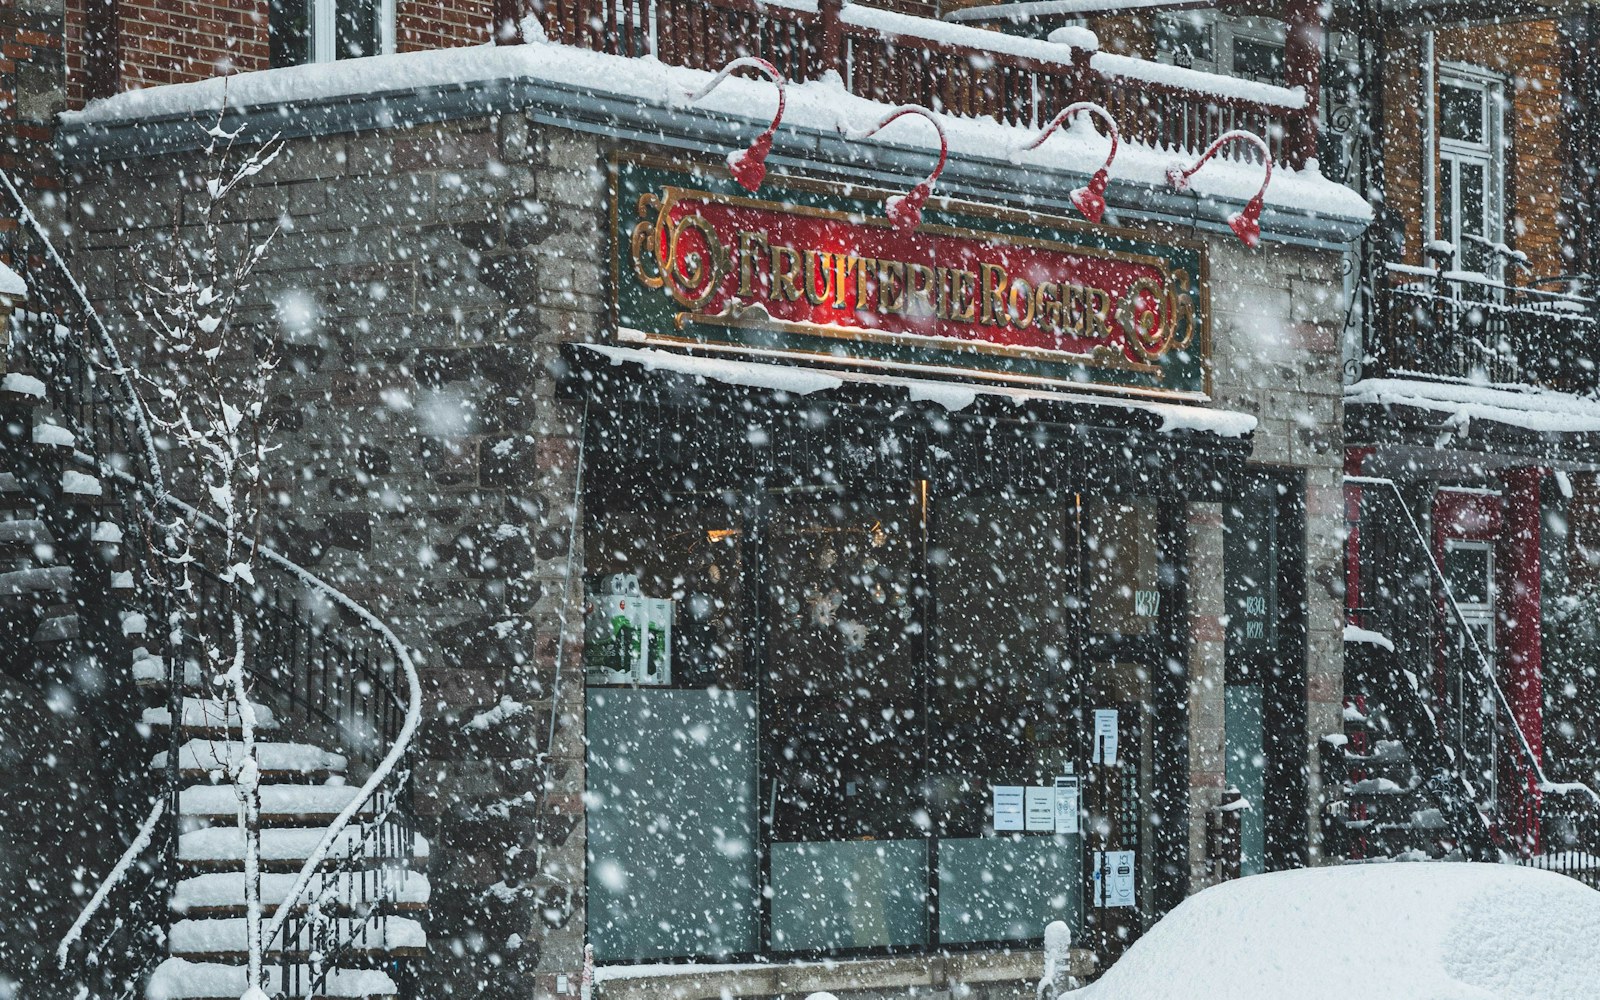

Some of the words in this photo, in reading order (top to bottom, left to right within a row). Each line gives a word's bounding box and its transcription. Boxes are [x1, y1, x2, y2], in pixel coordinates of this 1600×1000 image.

[738, 231, 974, 322] FRUITERIE
[980, 262, 1113, 338] ROGER
[1135, 591, 1160, 616] 1832
[1247, 621, 1263, 638] 1828
